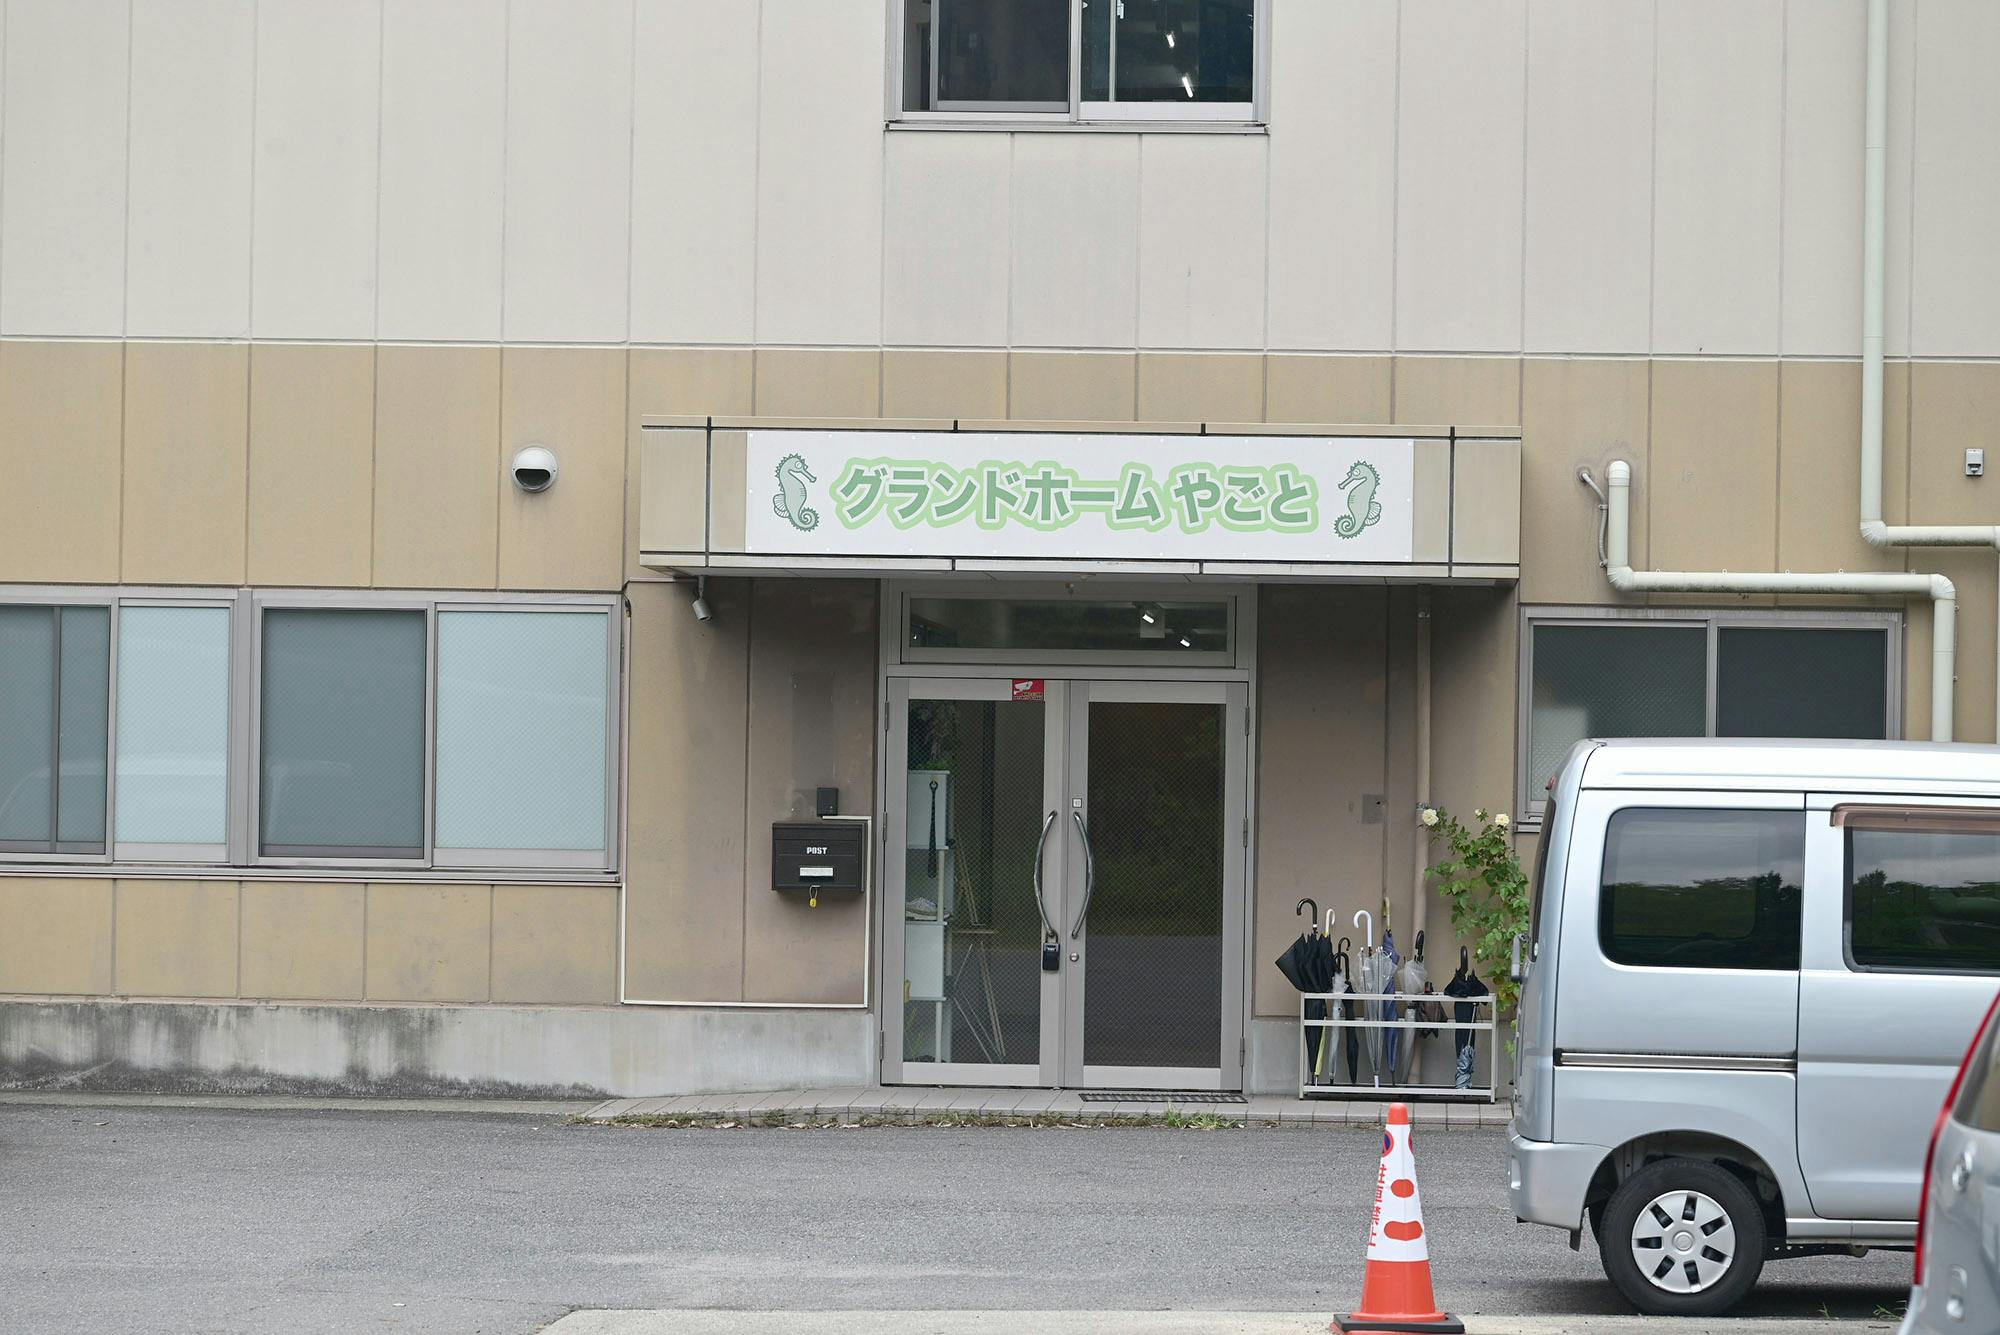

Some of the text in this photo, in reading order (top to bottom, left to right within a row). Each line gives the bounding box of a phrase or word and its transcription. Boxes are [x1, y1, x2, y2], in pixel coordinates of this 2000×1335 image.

[840, 467, 1309, 524] グランドホーム やごと
[806, 846, 828, 855] POST
